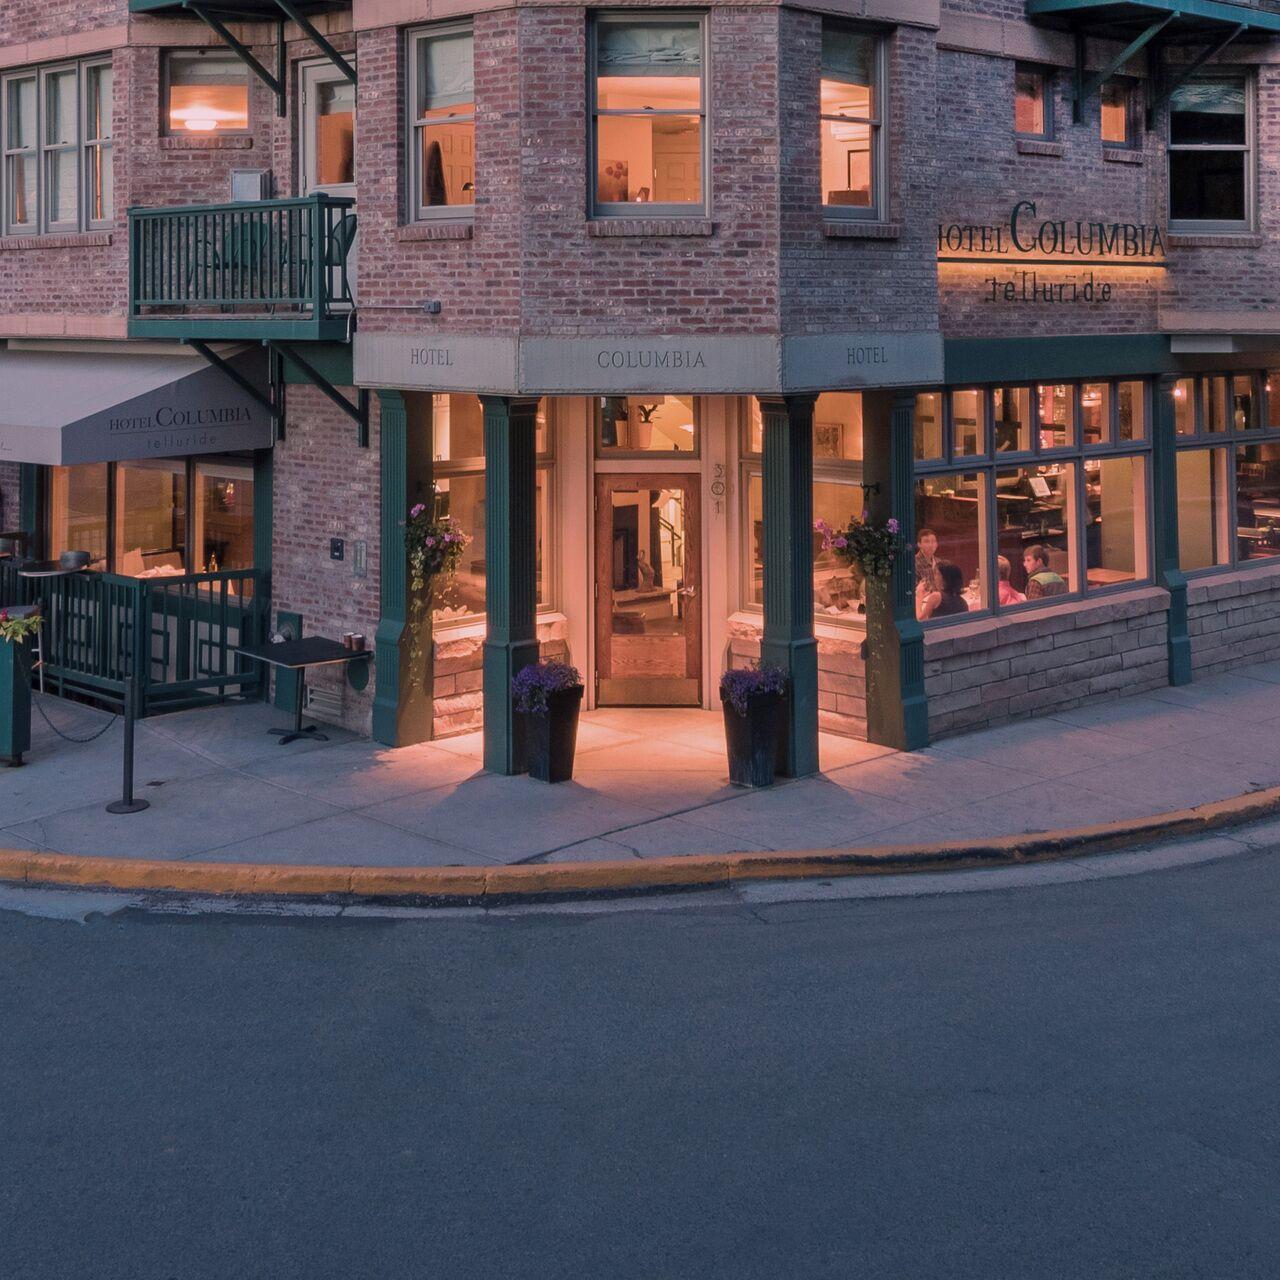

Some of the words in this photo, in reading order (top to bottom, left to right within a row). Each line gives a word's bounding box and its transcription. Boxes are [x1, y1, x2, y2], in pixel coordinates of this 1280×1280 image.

[1011, 200, 1166, 257] COLUMBIA
[989, 271, 1112, 303] telluride
[410, 348, 454, 366] HOTEL
[597, 350, 706, 369] COLUMBIA
[847, 346, 888, 365] HOTEL
[109, 416, 156, 431] HOTEL
[155, 407, 251, 427] COLUMBIA
[147, 431, 217, 449] telluride
